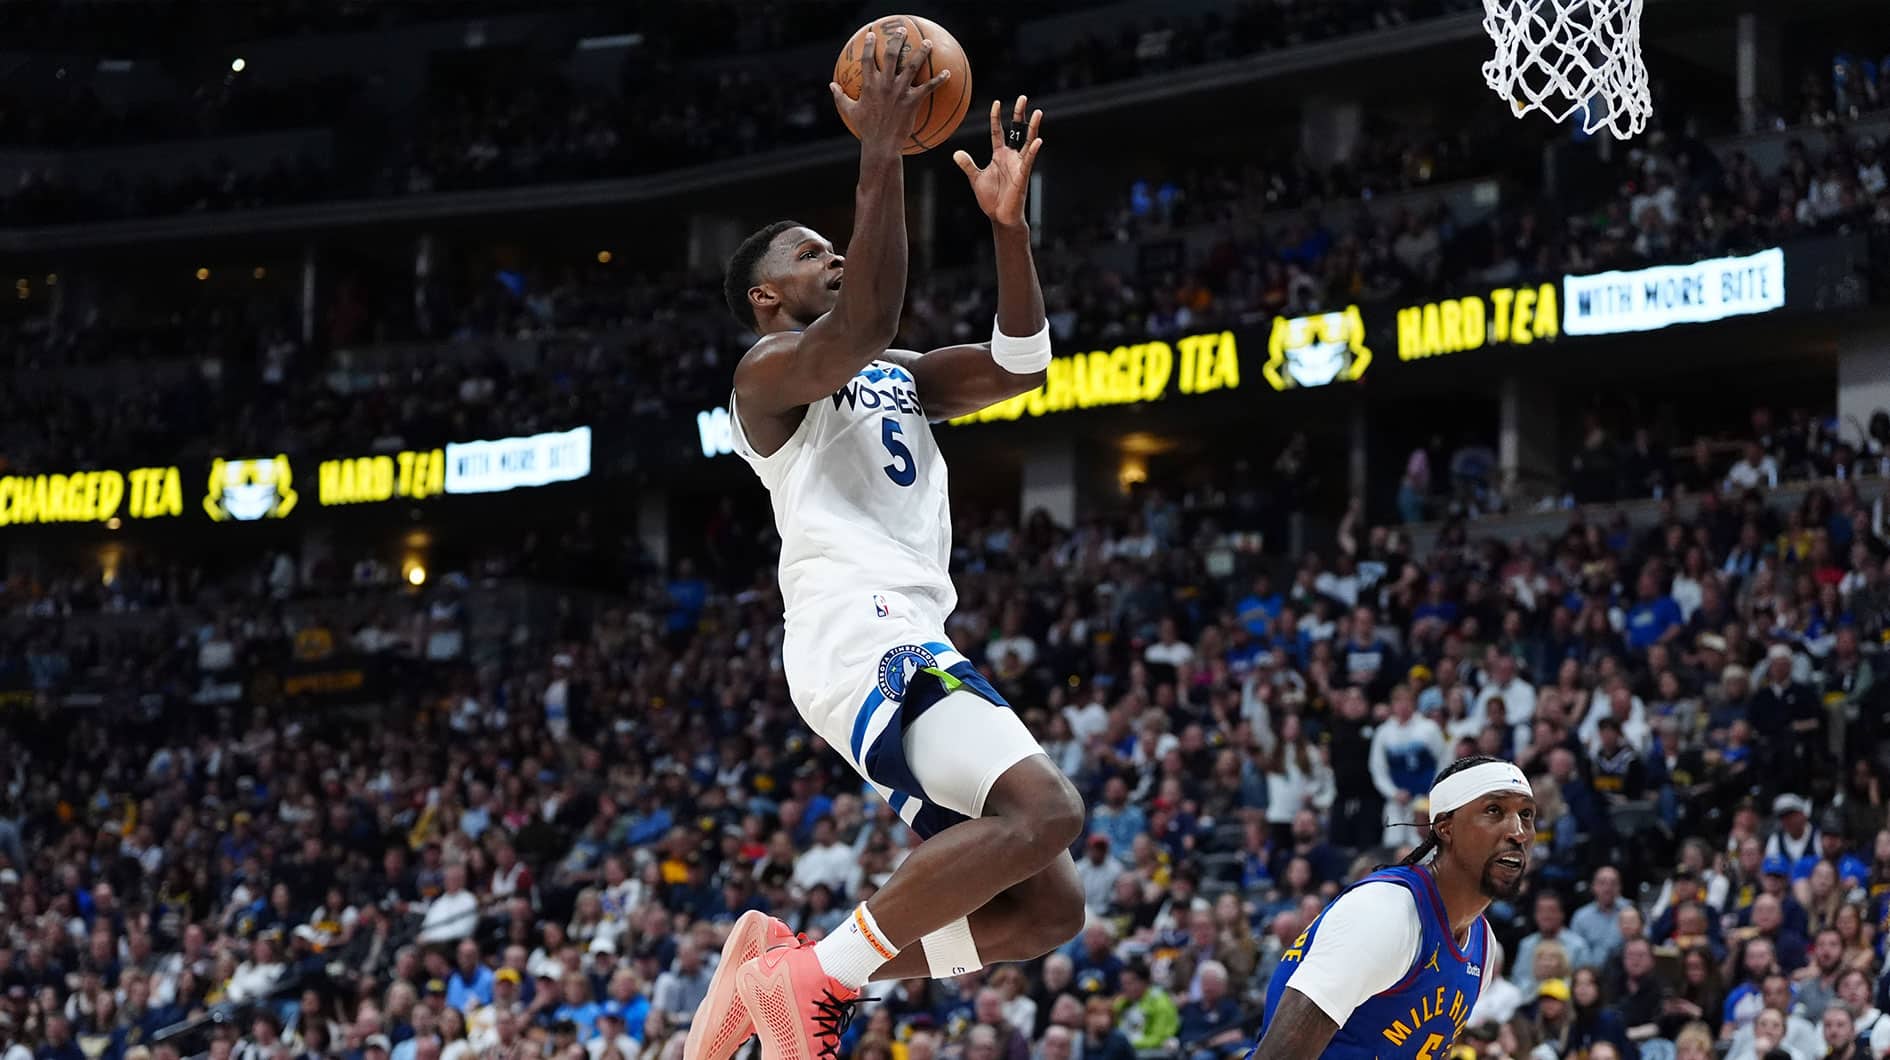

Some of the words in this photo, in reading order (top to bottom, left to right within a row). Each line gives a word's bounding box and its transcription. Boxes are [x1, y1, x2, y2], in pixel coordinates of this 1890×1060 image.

[1397, 296, 1485, 361] HARD
[1490, 282, 1558, 345] TEA
[1577, 285, 1633, 318] WITH
[1644, 273, 1705, 309] MORE
[1721, 265, 1770, 303] BITE
[1177, 331, 1239, 394] TEA
[319, 455, 394, 506] HARD
[397, 448, 444, 499] TEA
[880, 416, 917, 487] 5
[128, 466, 183, 518] TEA
[1382, 985, 1446, 1047] MILE
